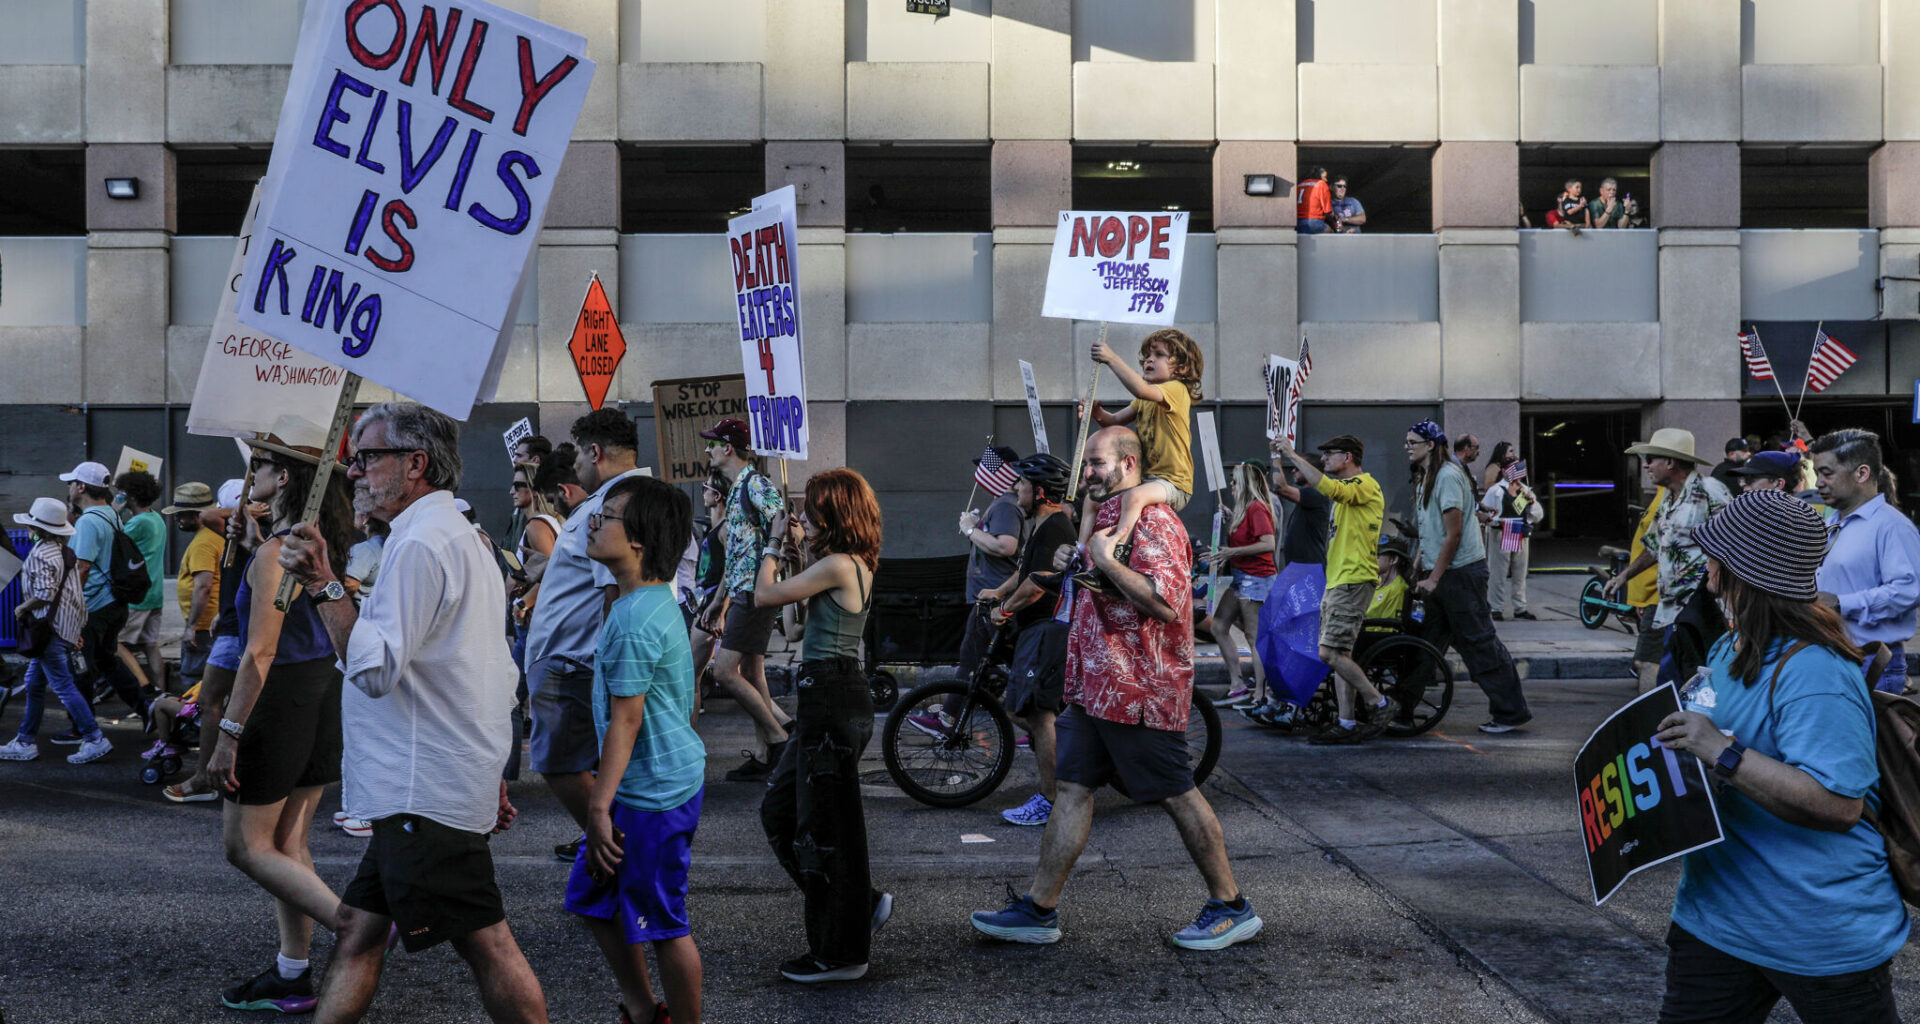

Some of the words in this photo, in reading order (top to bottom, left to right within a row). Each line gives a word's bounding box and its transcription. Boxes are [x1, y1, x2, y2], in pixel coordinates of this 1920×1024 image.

[345, 0, 578, 136] ONLY
[313, 69, 542, 235] ELVIS
[345, 189, 417, 272] IS
[730, 221, 790, 293] DEATH
[1103, 276, 1169, 295] JEFFERSON,
[737, 285, 796, 341] EATERS
[1128, 293, 1164, 313] 1776
[583, 309, 610, 330] RIGHT
[585, 333, 608, 353] LANE
[255, 364, 345, 386] WASHINGTON
[580, 355, 614, 376] CLOSED
[757, 338, 776, 395] 4
[678, 382, 721, 401] STOP
[512, 420, 529, 439] PEOPLE
[748, 395, 803, 453] TRUMP
[1580, 733, 1688, 854] RESIST
[1210, 917, 1235, 936] HOKA
